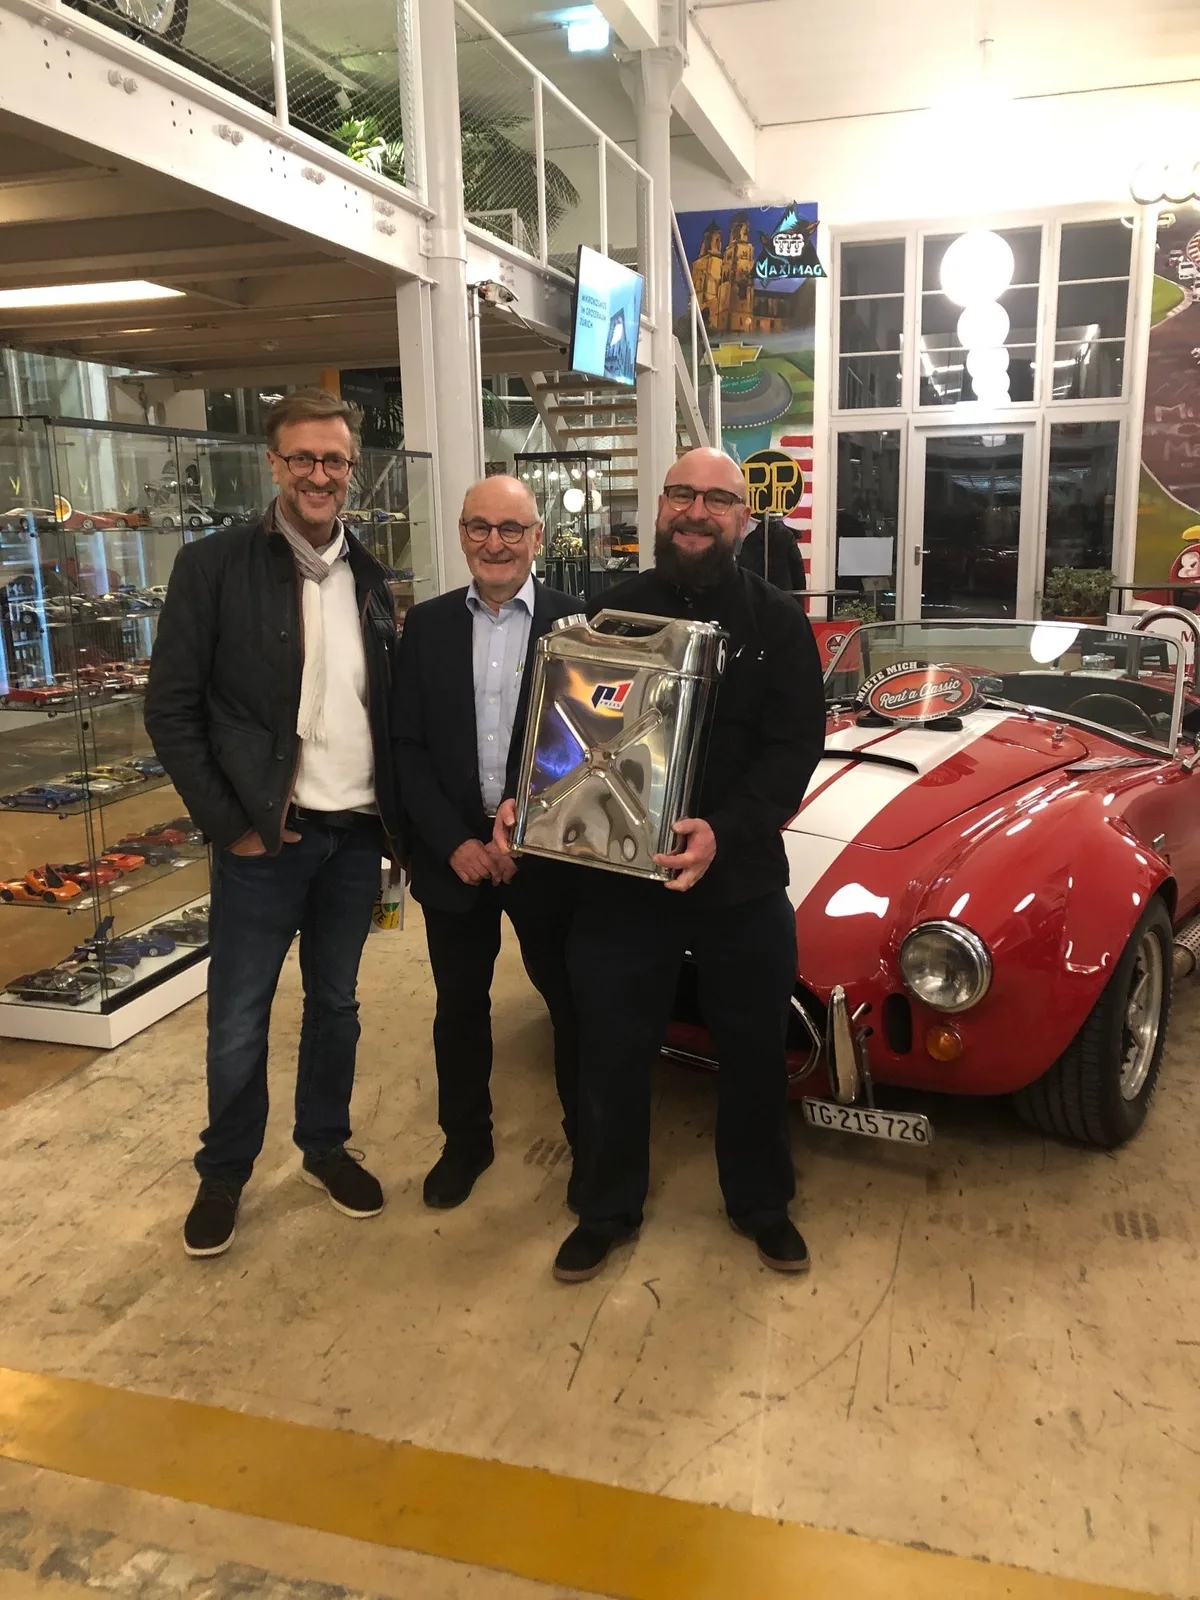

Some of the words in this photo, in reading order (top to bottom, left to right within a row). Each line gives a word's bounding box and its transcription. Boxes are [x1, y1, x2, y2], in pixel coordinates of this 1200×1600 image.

[756, 257, 822, 278] MAXIMAG
[855, 671, 886, 702] MIETE
[886, 661, 918, 676] MICH
[879, 691, 908, 708] Rent
[908, 690, 918, 700] a
[919, 678, 961, 700] Classic
